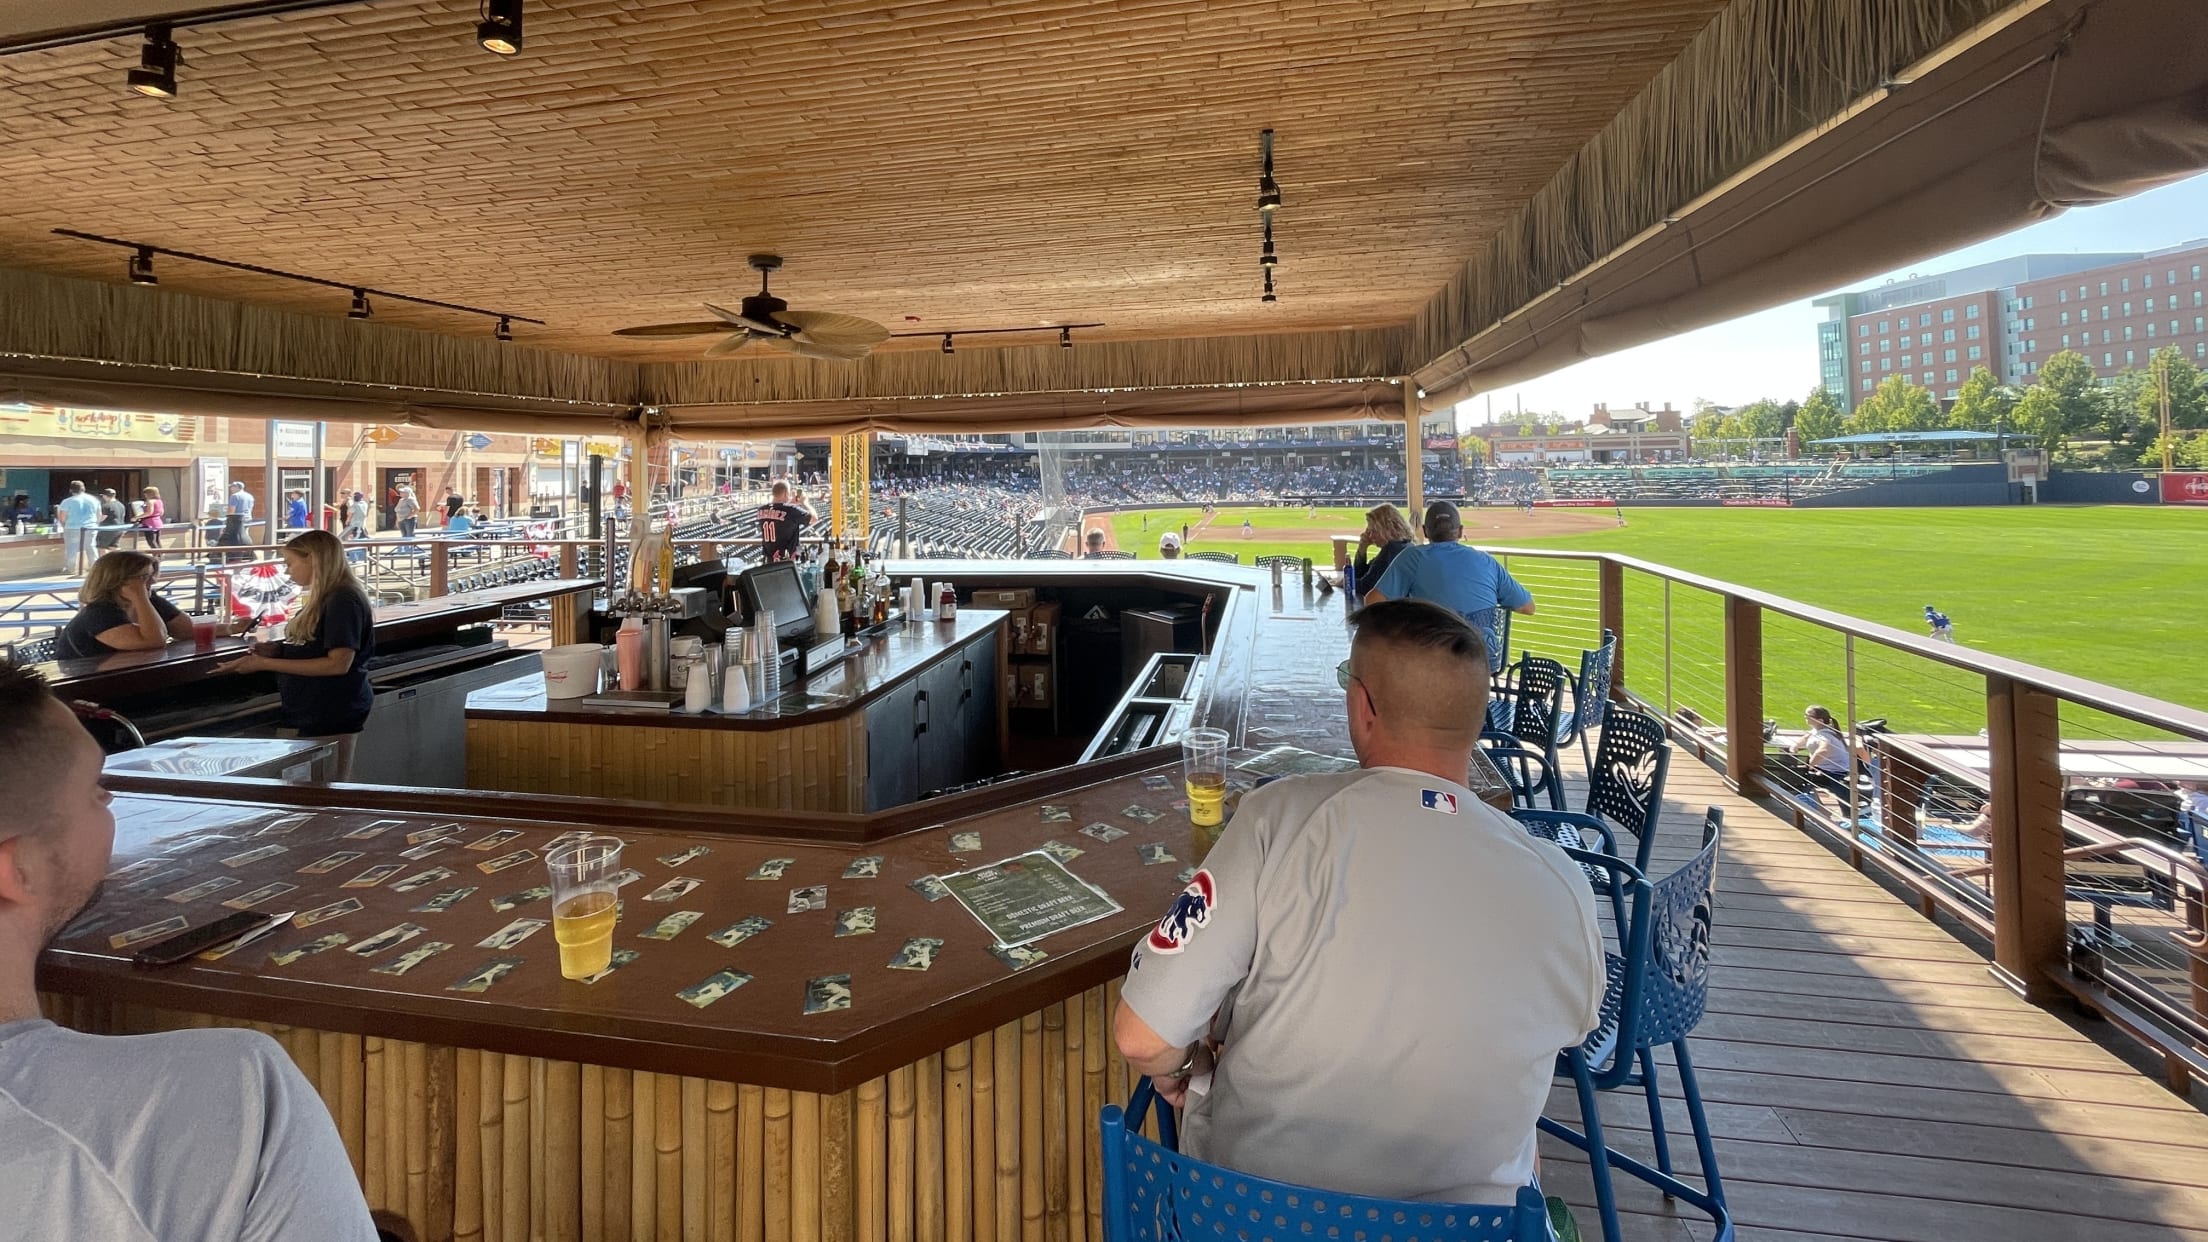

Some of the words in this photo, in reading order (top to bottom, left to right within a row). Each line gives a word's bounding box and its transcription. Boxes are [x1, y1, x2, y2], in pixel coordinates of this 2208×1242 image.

[763, 521, 775, 542] 11
[1005, 906, 1037, 919] DOMESTIC
[1037, 899, 1058, 909] DRAFT
[1019, 917, 1050, 930] PREMIUM
[1049, 910, 1070, 921] DRAFT
